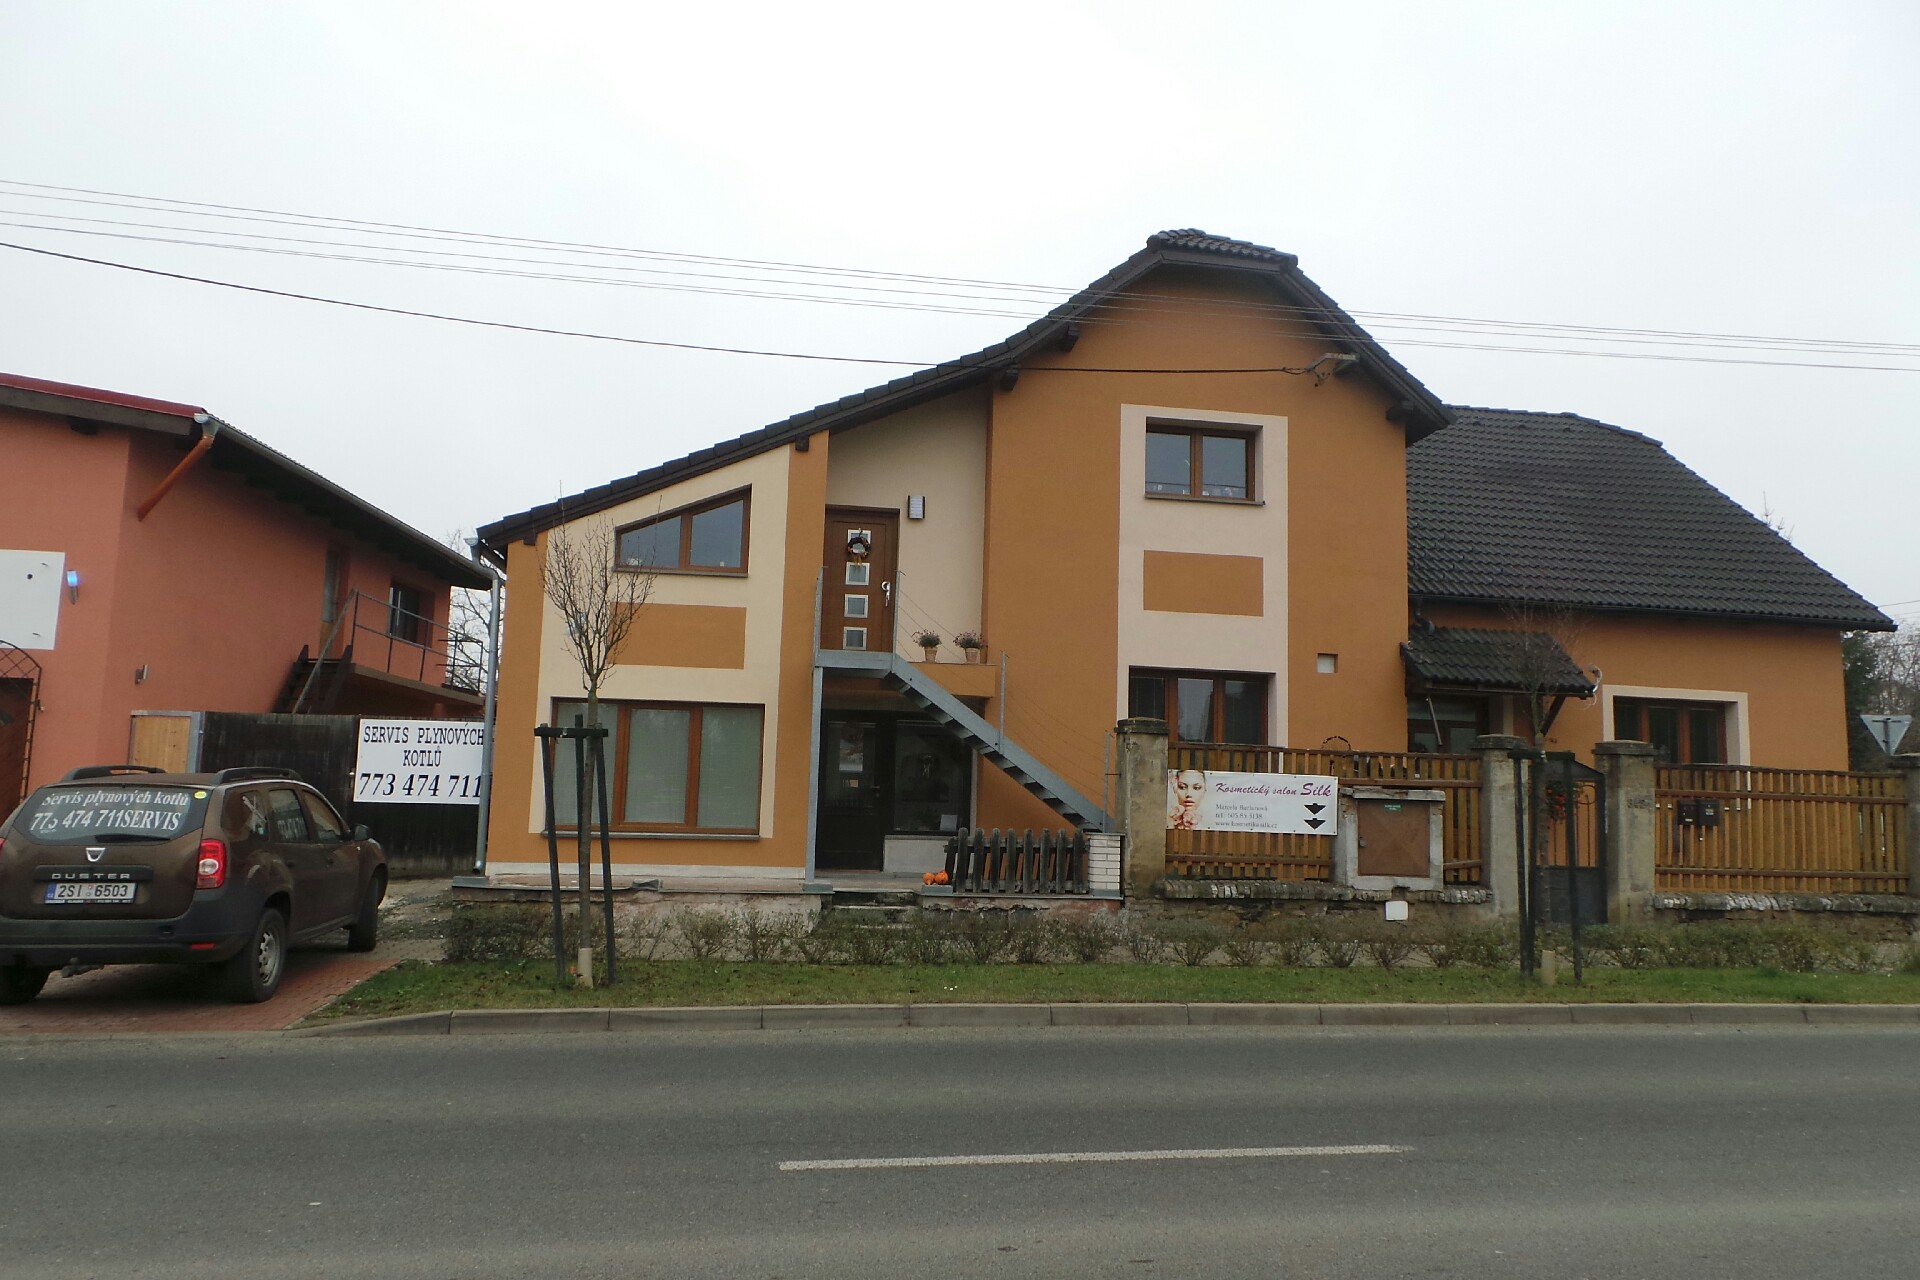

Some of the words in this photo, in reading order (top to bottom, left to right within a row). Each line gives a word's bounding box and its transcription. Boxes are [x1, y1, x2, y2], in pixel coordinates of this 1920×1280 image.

[363, 726, 409, 744] SERVIS
[417, 722, 484, 745] PLYNOVÝCH
[403, 745, 442, 767] KOTLŮ
[359, 772, 396, 796] 773
[402, 773, 440, 797] 474
[448, 774, 482, 798] 711
[1215, 782, 1270, 796] Kosmetický
[1272, 786, 1297, 795] salon
[1300, 782, 1332, 796] Silk
[82, 790, 151, 807] plynových
[154, 791, 190, 806] kotlů
[62, 810, 94, 828] 474
[94, 885, 128, 897] 6503
